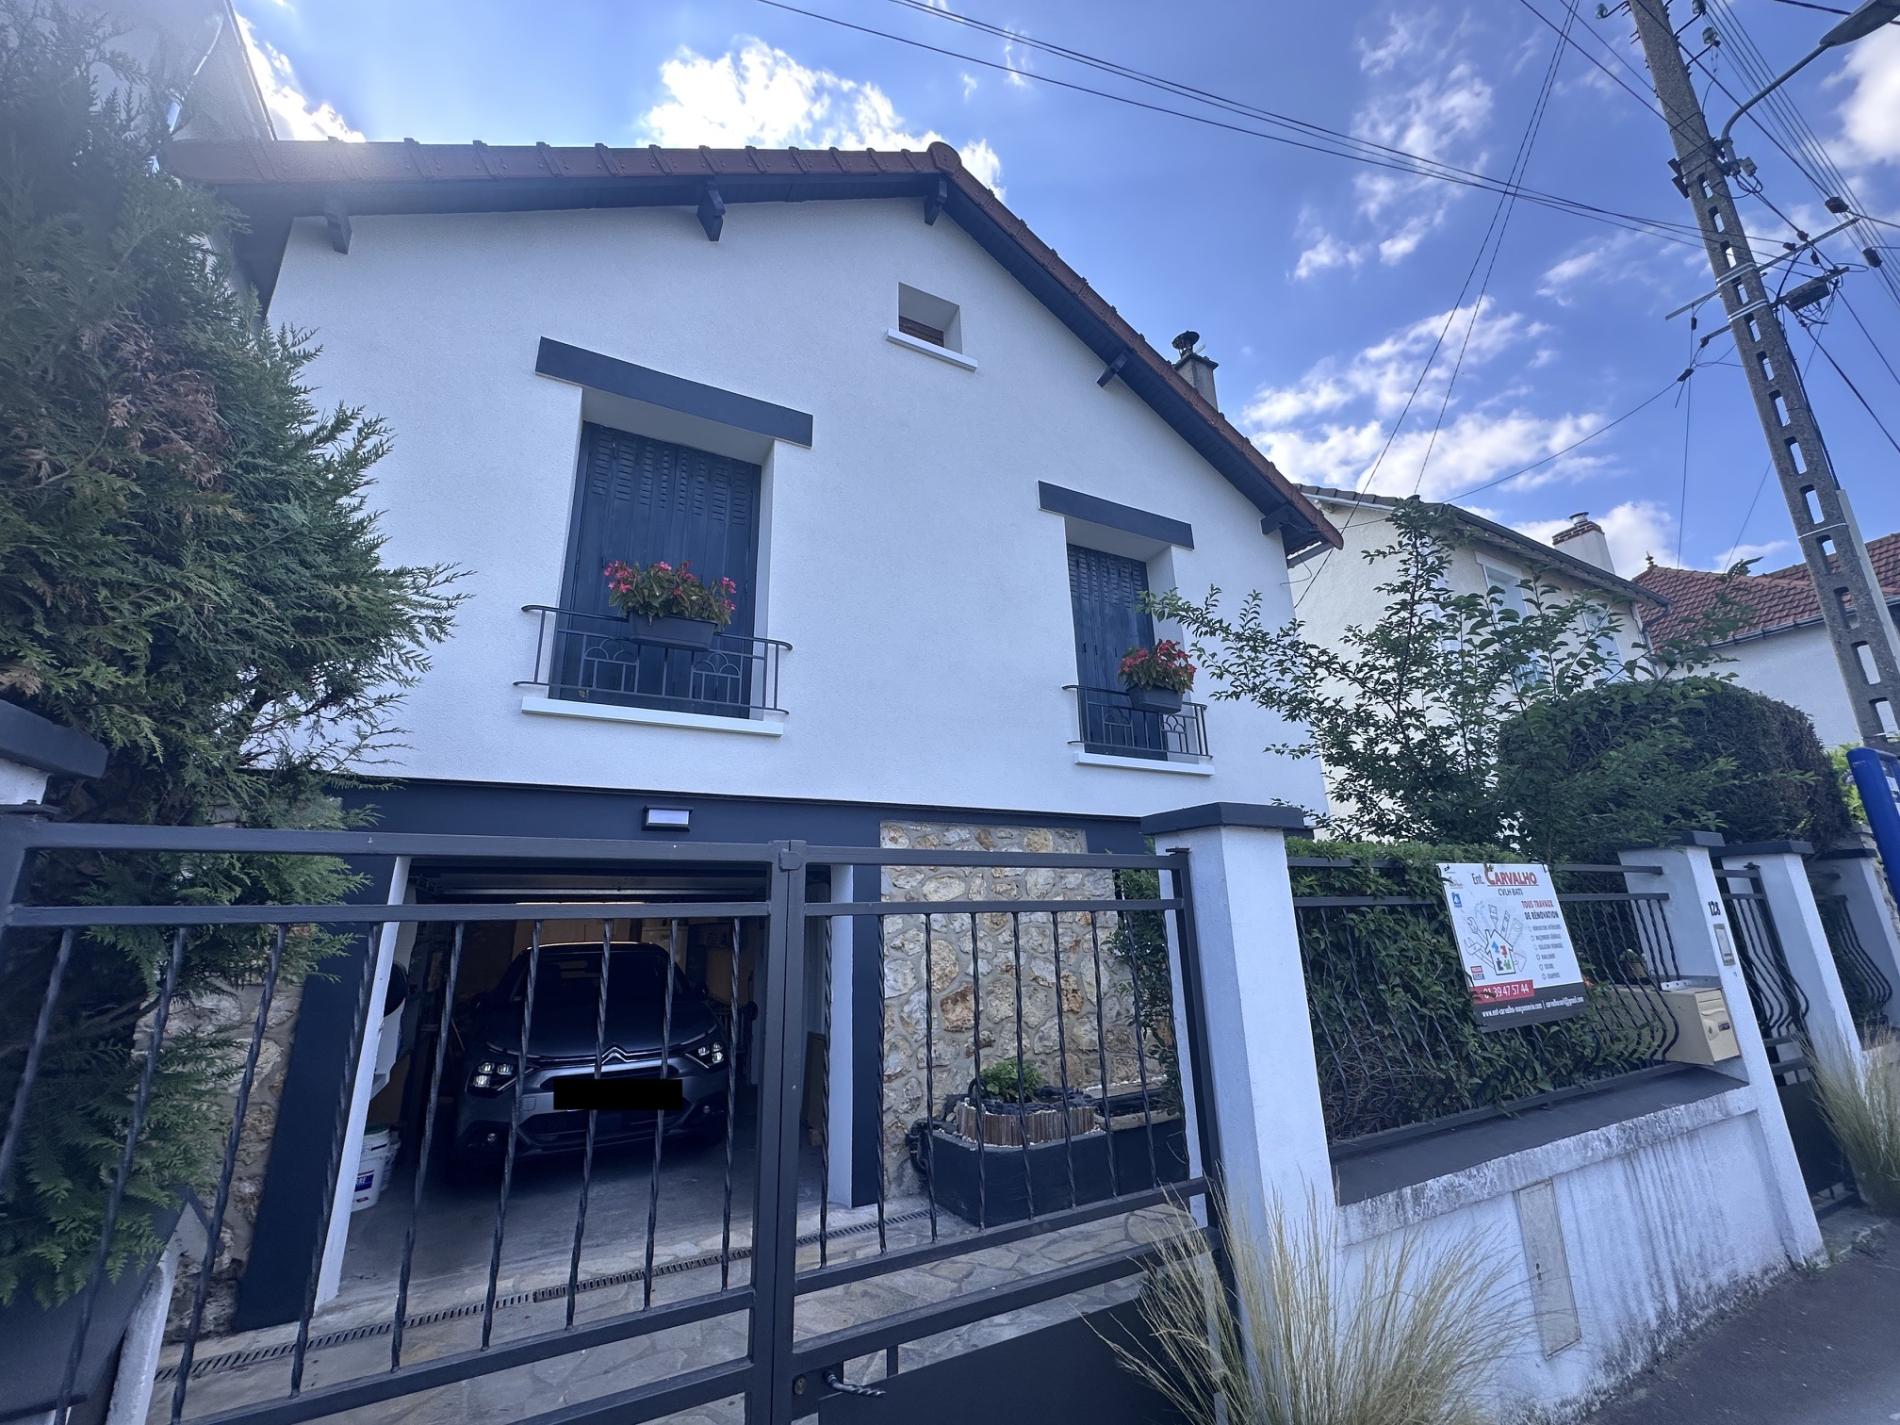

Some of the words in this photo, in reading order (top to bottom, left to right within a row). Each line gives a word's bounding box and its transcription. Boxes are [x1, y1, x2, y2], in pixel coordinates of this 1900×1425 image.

[1472, 872, 1484, 885] Ent.
[1484, 864, 1538, 885] CARVALHO
[1521, 900, 1534, 909] TOUS
[1533, 899, 1554, 908] TRAVAUX
[1524, 911, 1532, 920] DE
[1503, 985, 1511, 997] 47
[1511, 984, 1519, 995] 57
[1520, 983, 1529, 993] 44
